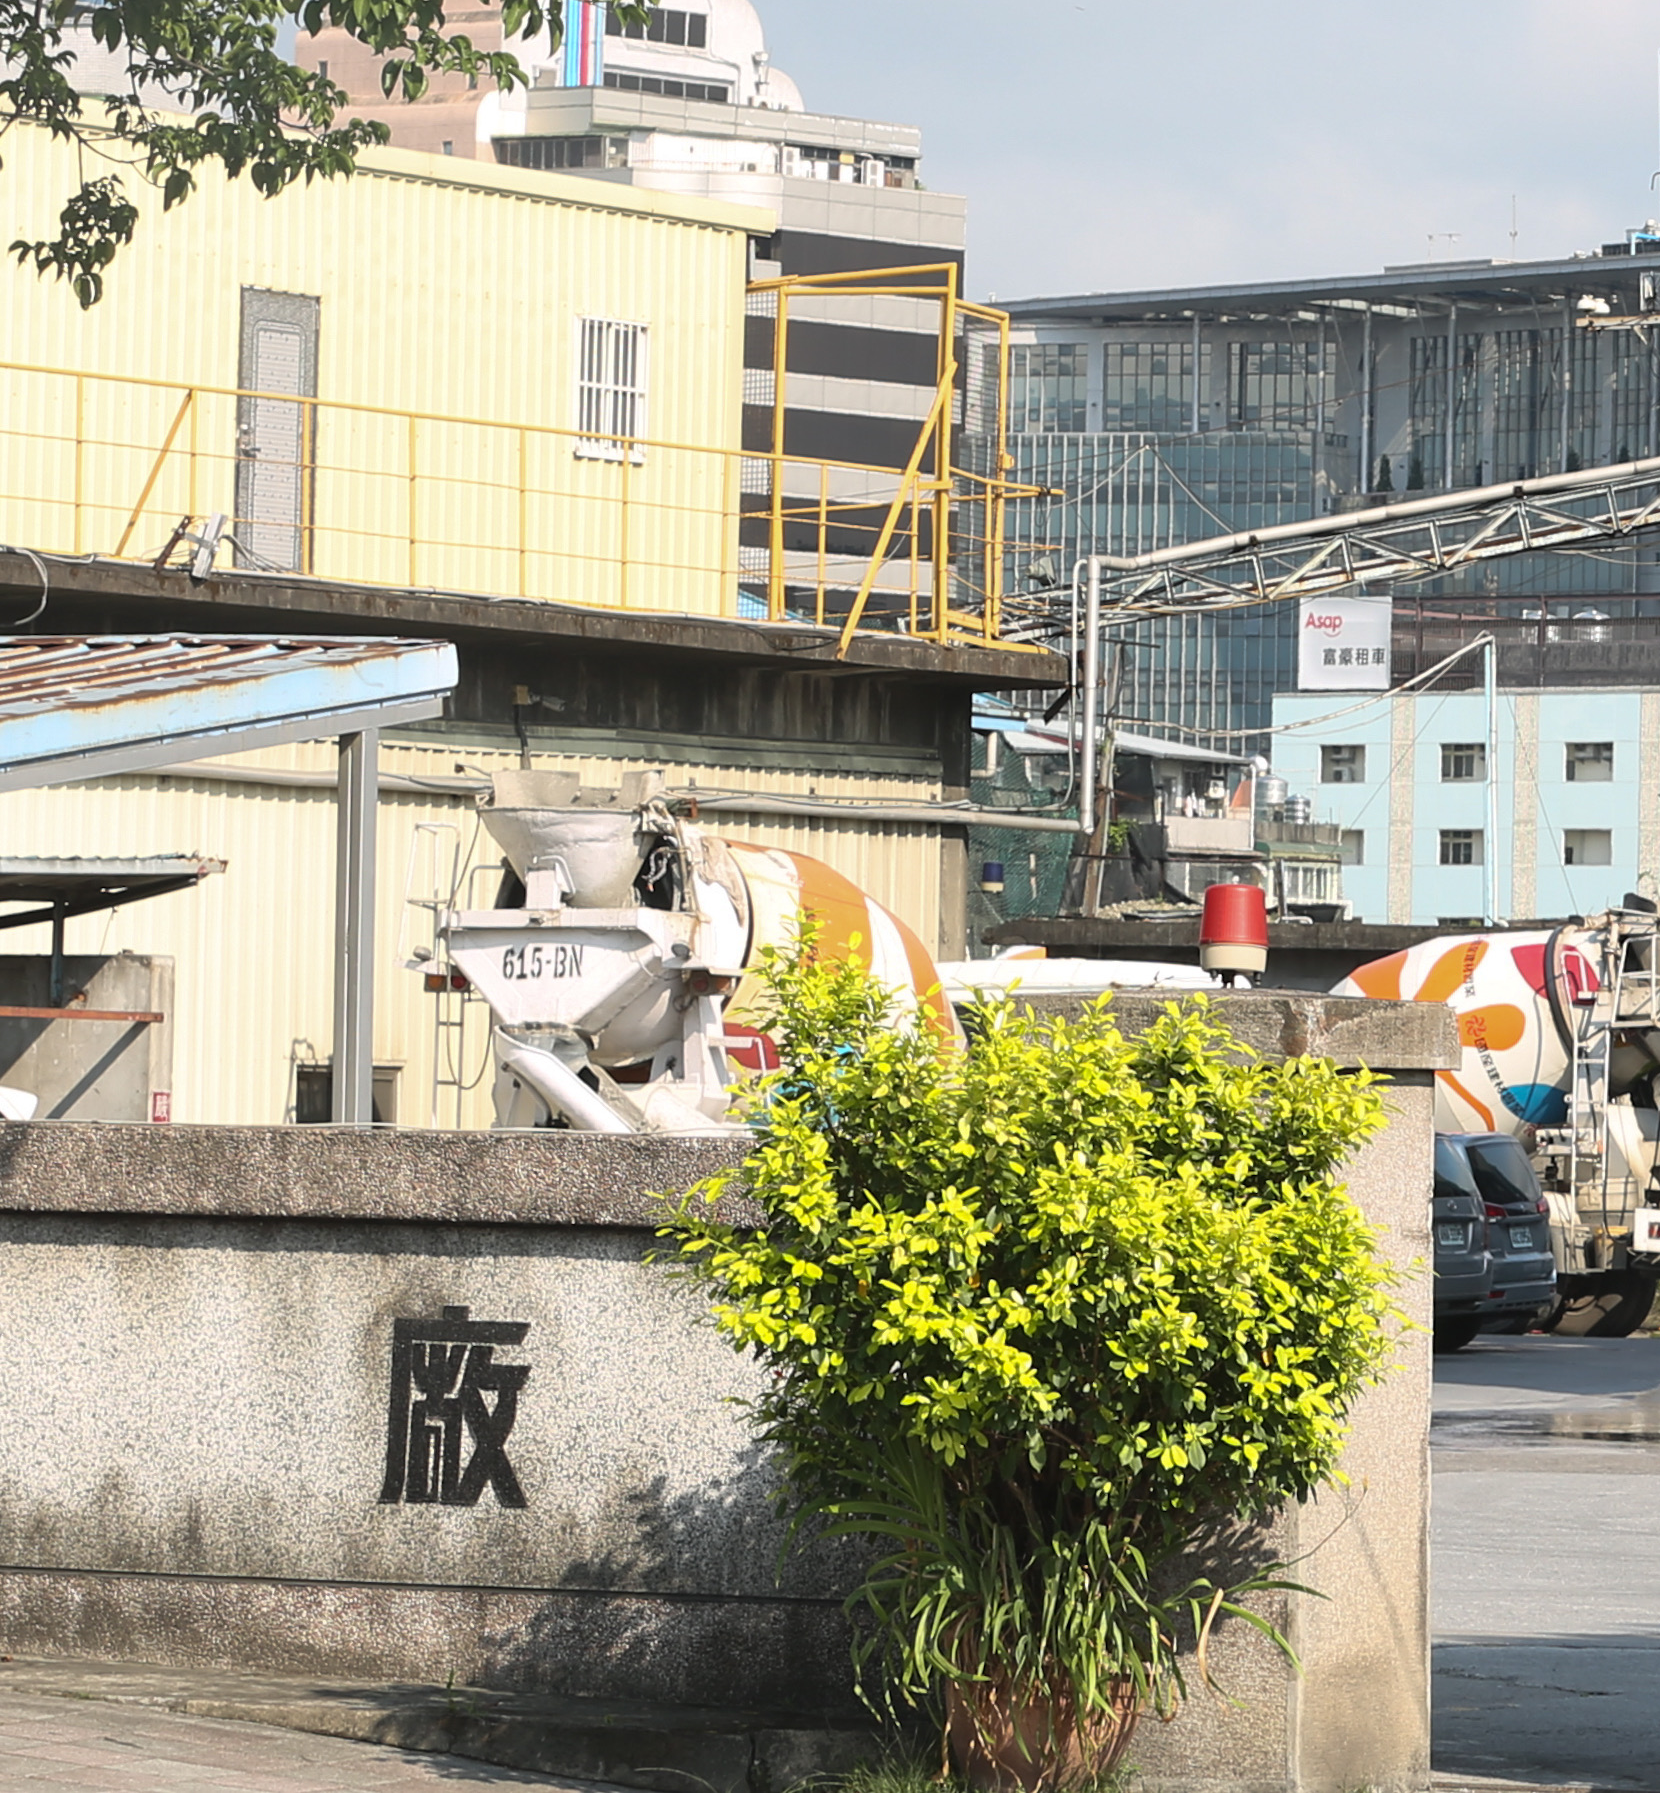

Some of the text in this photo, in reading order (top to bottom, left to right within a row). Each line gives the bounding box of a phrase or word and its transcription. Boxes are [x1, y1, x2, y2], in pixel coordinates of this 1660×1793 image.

[1305, 612, 1343, 633] Asap
[1323, 647, 1386, 666] 富豪租車
[502, 944, 584, 980] 615-BN
